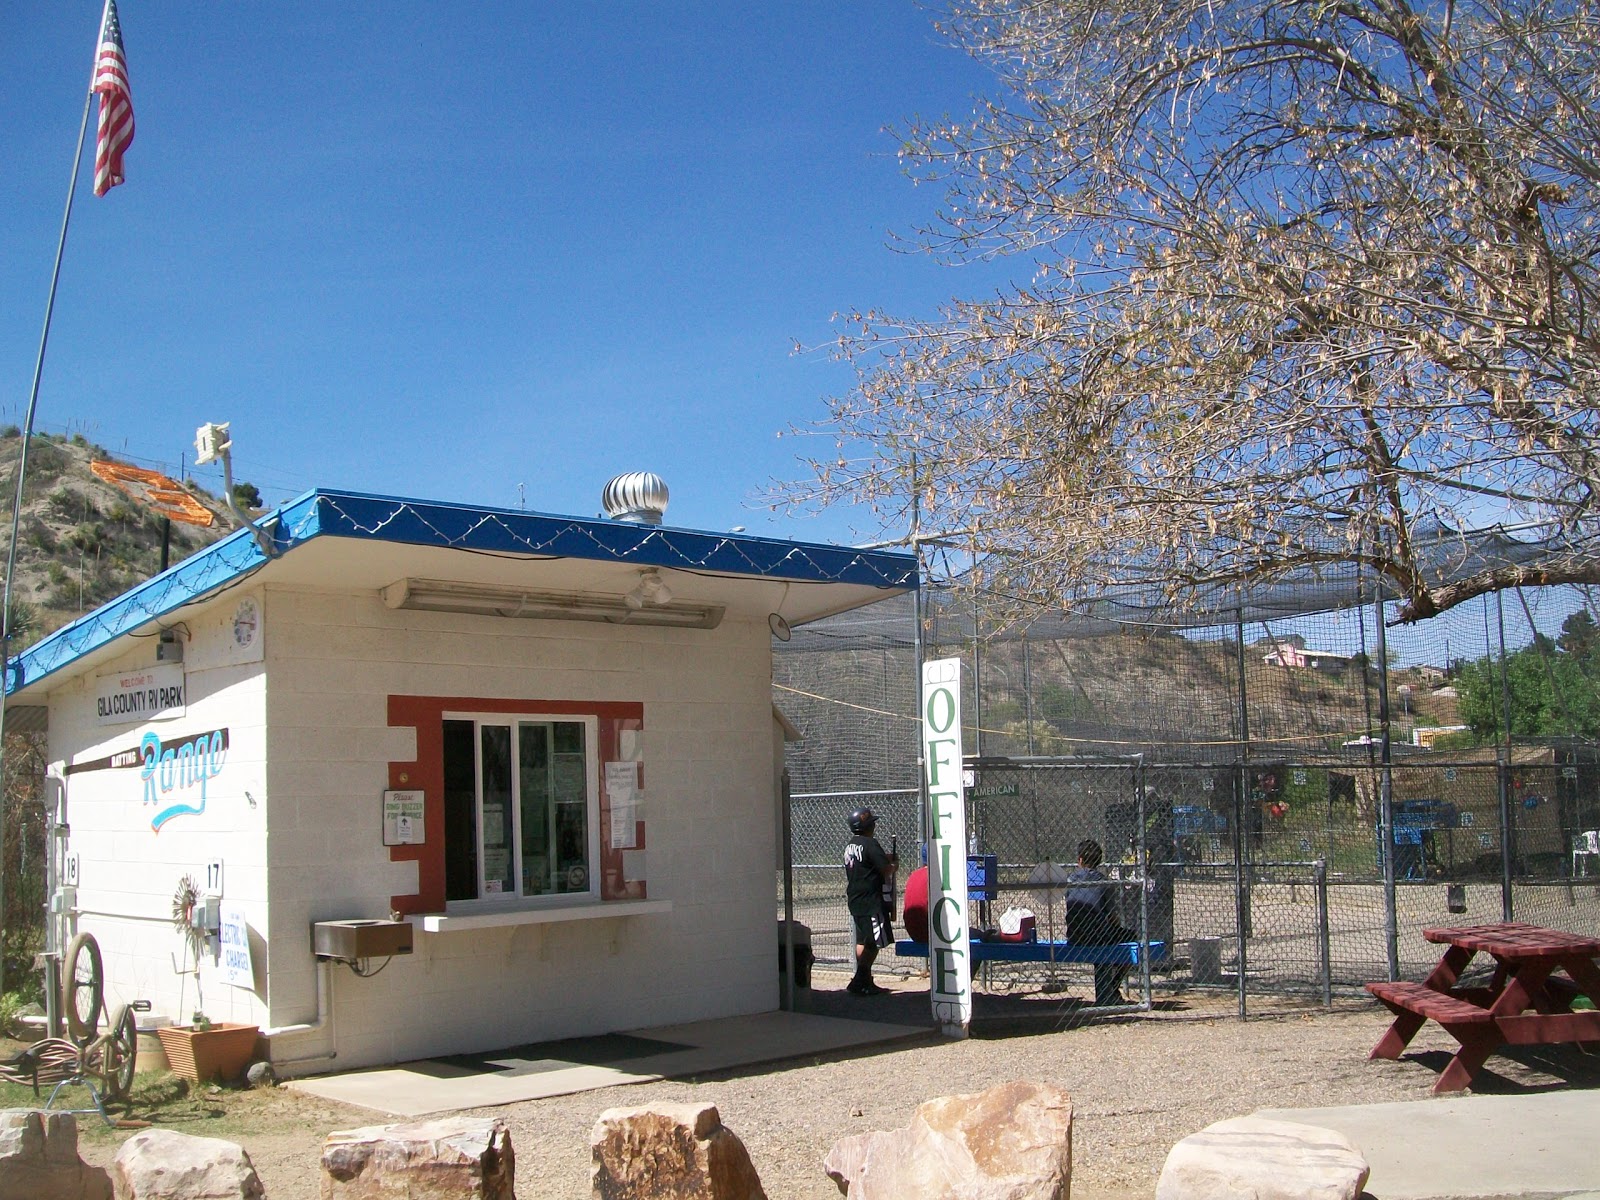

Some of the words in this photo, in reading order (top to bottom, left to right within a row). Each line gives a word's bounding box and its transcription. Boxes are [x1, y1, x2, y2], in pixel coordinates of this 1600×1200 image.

[120, 677, 145, 688] WELCOME
[97, 696, 113, 717] GILA
[113, 690, 146, 715] COUNTY
[148, 688, 159, 710] RV
[159, 686, 183, 709] PARK
[111, 751, 136, 768] BATTING
[973, 785, 1015, 797] AMERICAN
[401, 802, 423, 811] BUZZER
[926, 687, 966, 997] OFFICE
[67, 857, 76, 879] 18
[207, 863, 220, 889] 17
